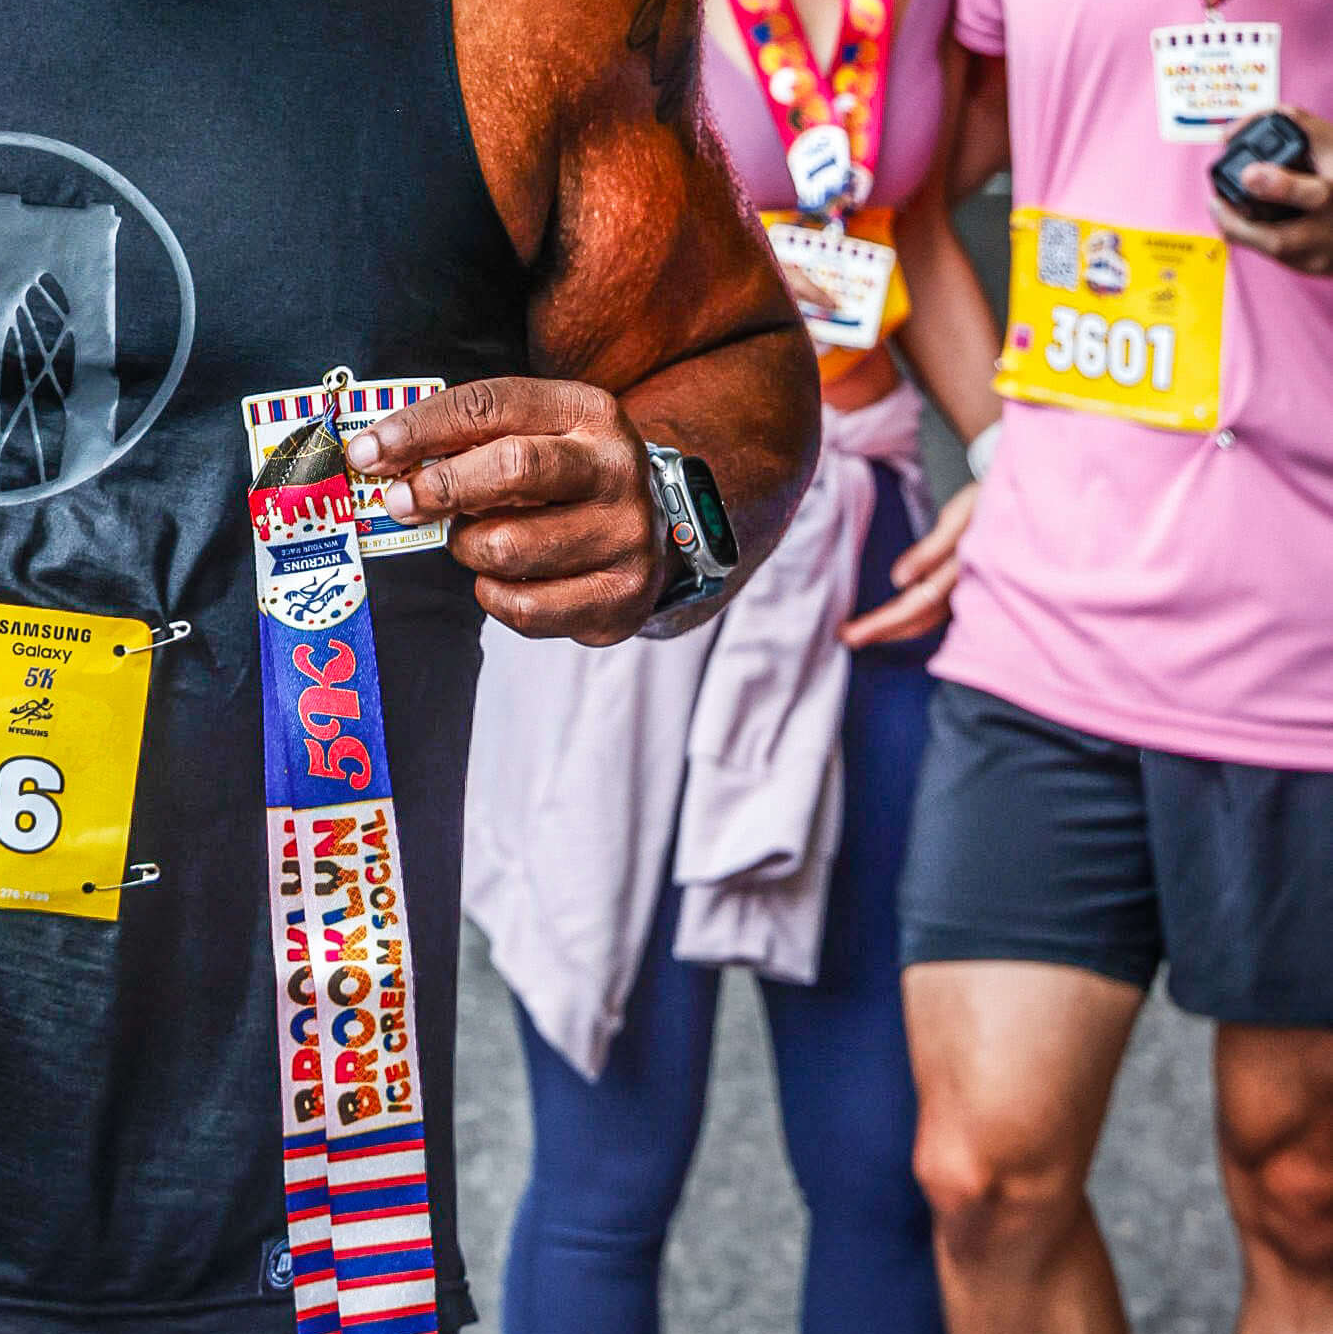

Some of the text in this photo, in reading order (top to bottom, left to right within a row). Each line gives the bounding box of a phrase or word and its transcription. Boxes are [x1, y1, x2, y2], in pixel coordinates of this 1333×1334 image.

[1044, 305, 1176, 393] 3601
[336, 418, 377, 432] CRUNS
[282, 553, 342, 572] NYCRUNS
[12, 642, 73, 665] Galaxy
[24, 666, 58, 690] 5K
[291, 638, 372, 791] 5K
[7, 725, 49, 738] NYCRUNS
[312, 816, 383, 1127] BROOKLYN
[360, 808, 413, 1114] ICE CREAM SOCIAL
